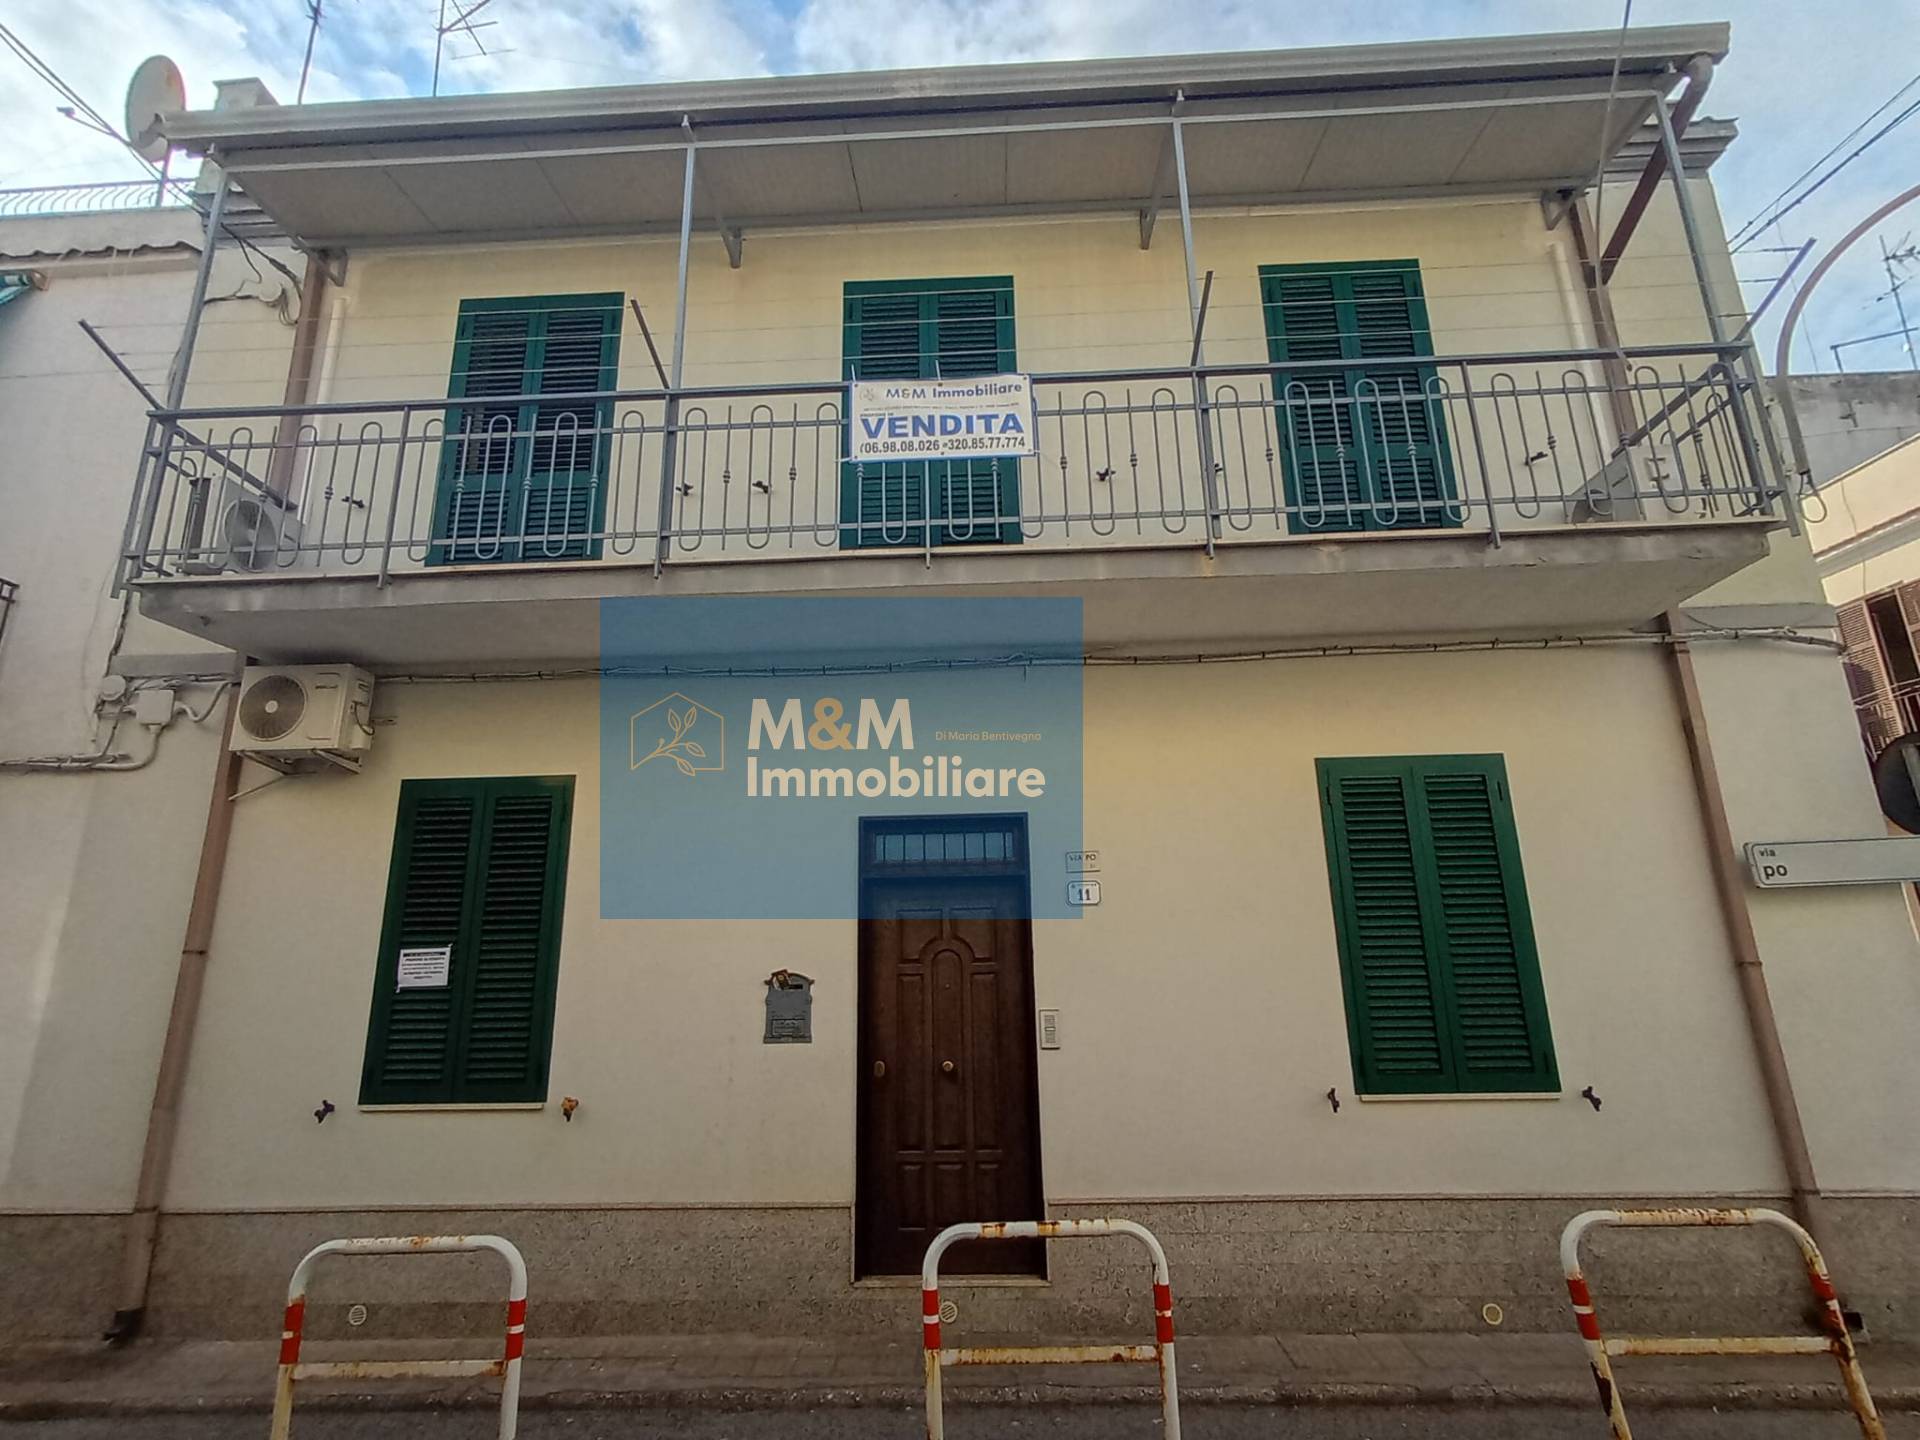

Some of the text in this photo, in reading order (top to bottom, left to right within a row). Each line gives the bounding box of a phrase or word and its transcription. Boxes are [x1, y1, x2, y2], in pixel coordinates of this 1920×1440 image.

[886, 382, 1022, 399] M&M Immobiliare
[861, 413, 1024, 438] VENDITA
[1759, 847, 1776, 857] via
[1763, 864, 1788, 880] po
[1078, 888, 1091, 901] 11
